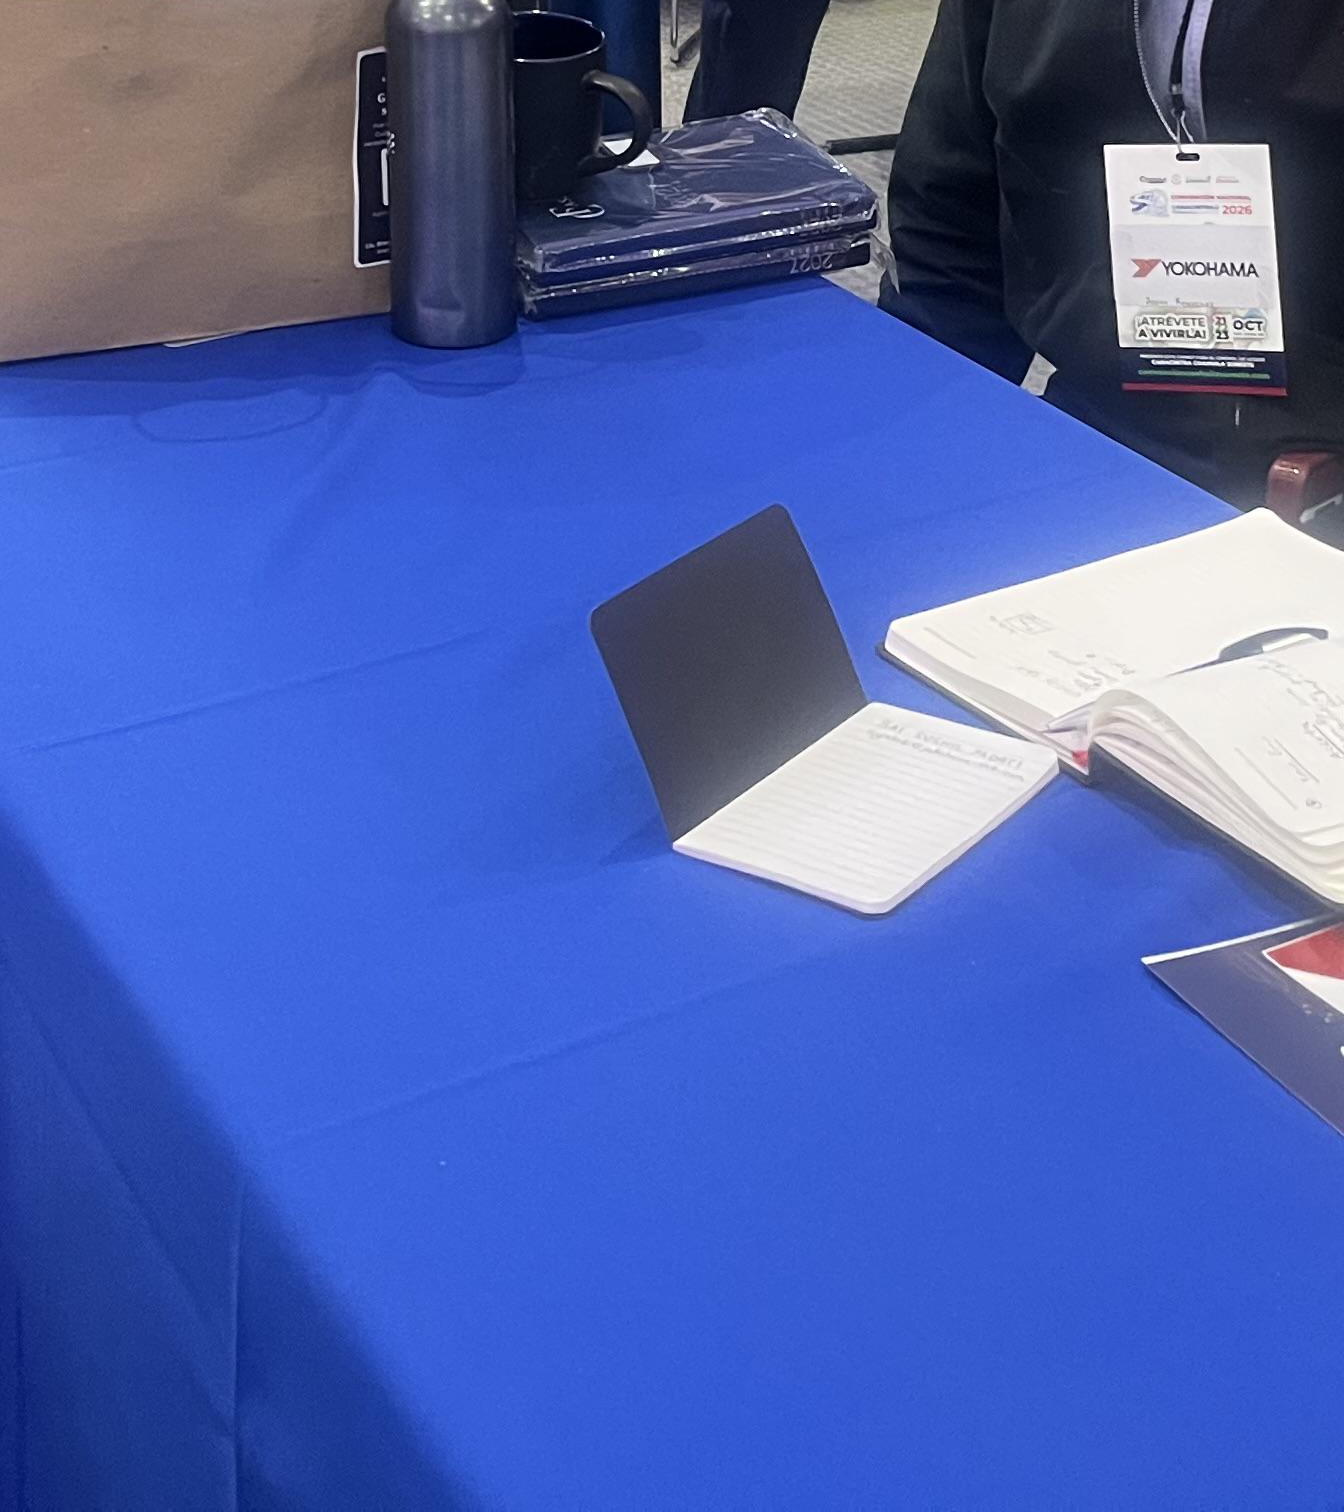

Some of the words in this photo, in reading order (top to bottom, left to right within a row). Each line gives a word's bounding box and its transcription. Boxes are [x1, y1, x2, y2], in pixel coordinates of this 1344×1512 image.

[1222, 204, 1253, 215] 2026
[1162, 261, 1259, 278] YOKOHAMA
[1233, 319, 1264, 332] OCT
